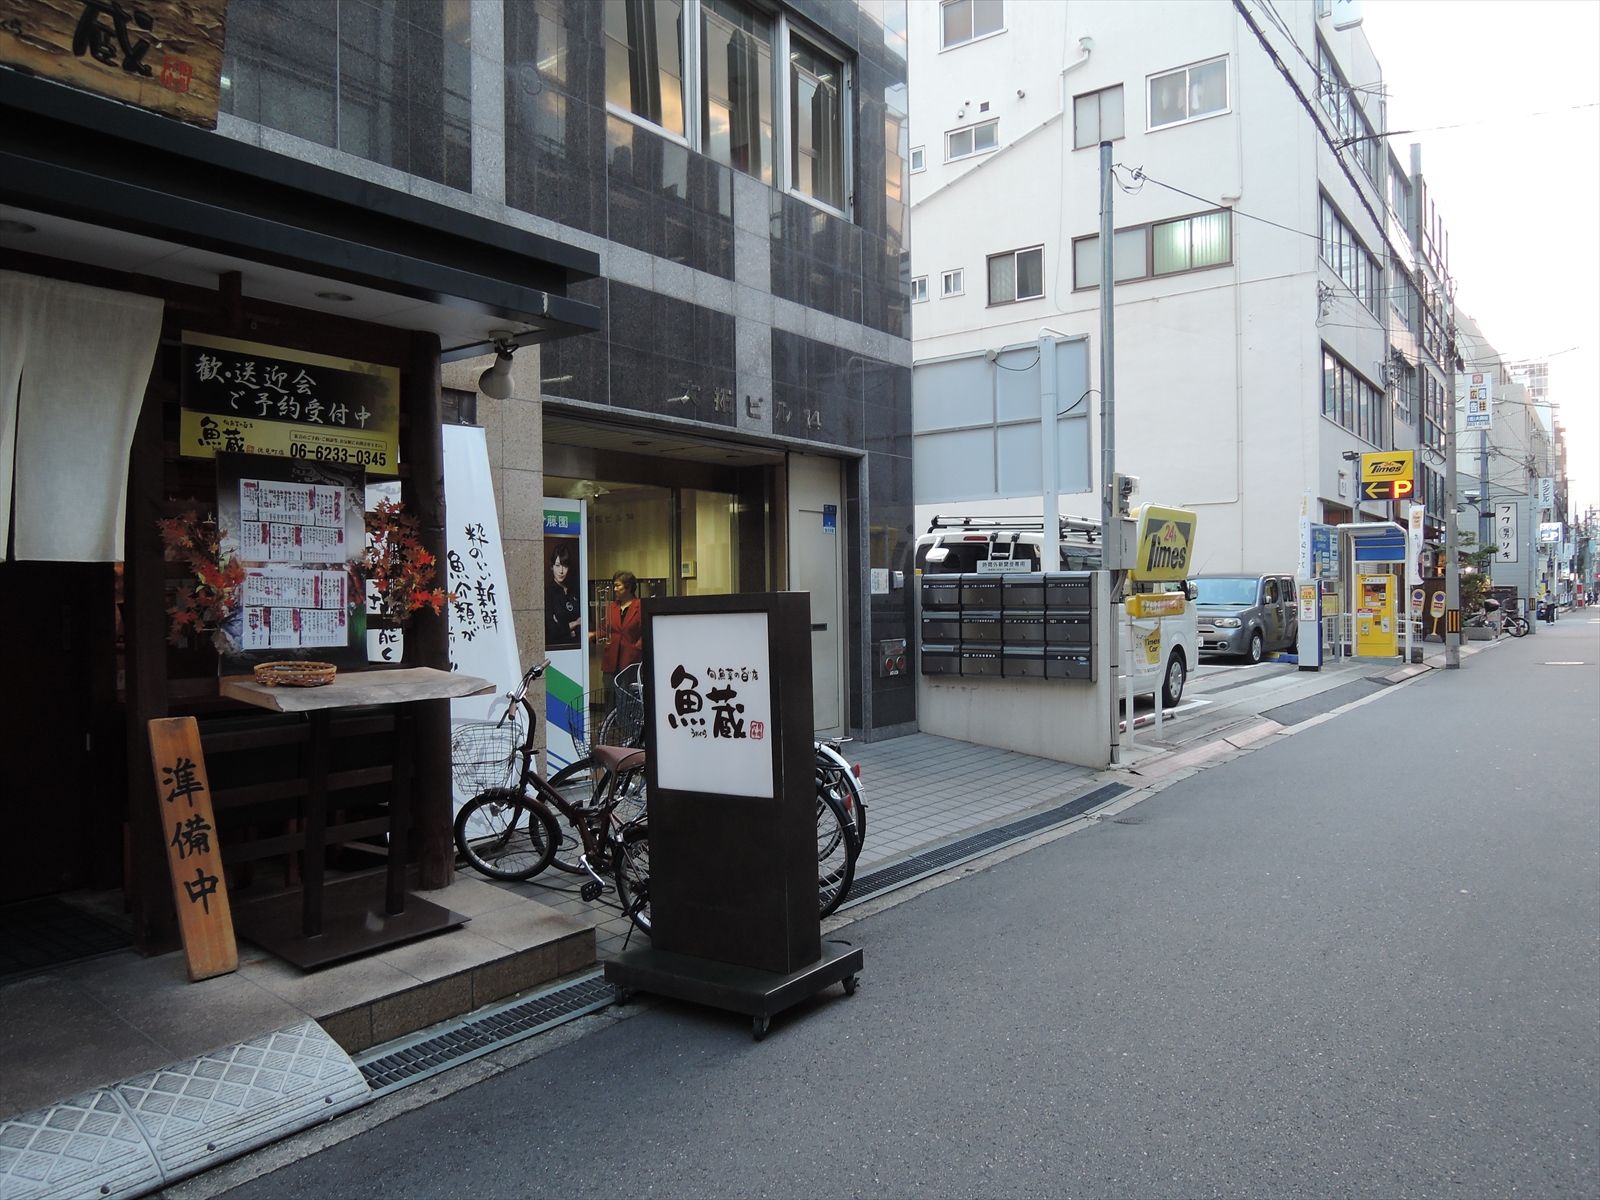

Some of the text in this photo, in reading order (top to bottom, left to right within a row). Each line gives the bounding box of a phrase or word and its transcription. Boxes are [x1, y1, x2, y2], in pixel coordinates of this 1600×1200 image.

[230, 389, 372, 430] ご予約受付中
[290, 442, 387, 466] 06-6233-0345
[1370, 461, 1402, 475] Times
[1393, 480, 1413, 499] P
[1146, 534, 1187, 572] Times
[447, 549, 480, 642] 魚介類が
[464, 523, 498, 634] 粋のいい新鮮
[668, 664, 747, 739] 魚蔵
[161, 756, 220, 915] 準備中
